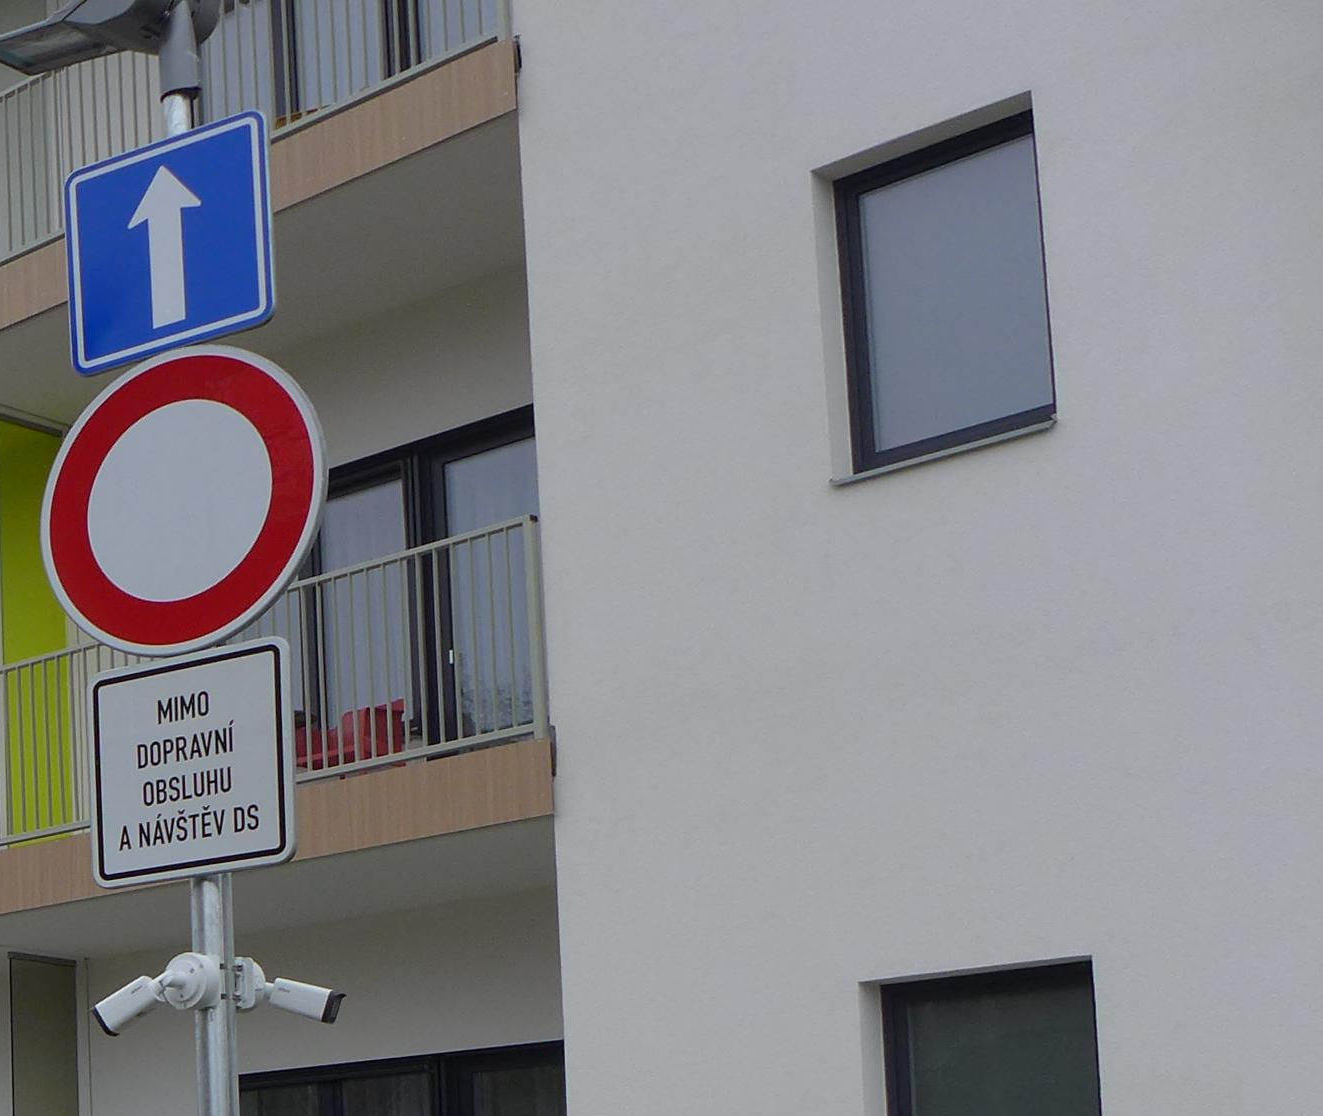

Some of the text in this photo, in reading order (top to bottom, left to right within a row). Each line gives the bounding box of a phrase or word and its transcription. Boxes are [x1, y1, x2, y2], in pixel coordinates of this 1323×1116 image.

[157, 690, 210, 725] MIMO
[136, 719, 235, 770] DOPRAVNÍ
[142, 766, 232, 807] OBSLUHU
[118, 803, 260, 852] A NÁVŠTĚV DS
